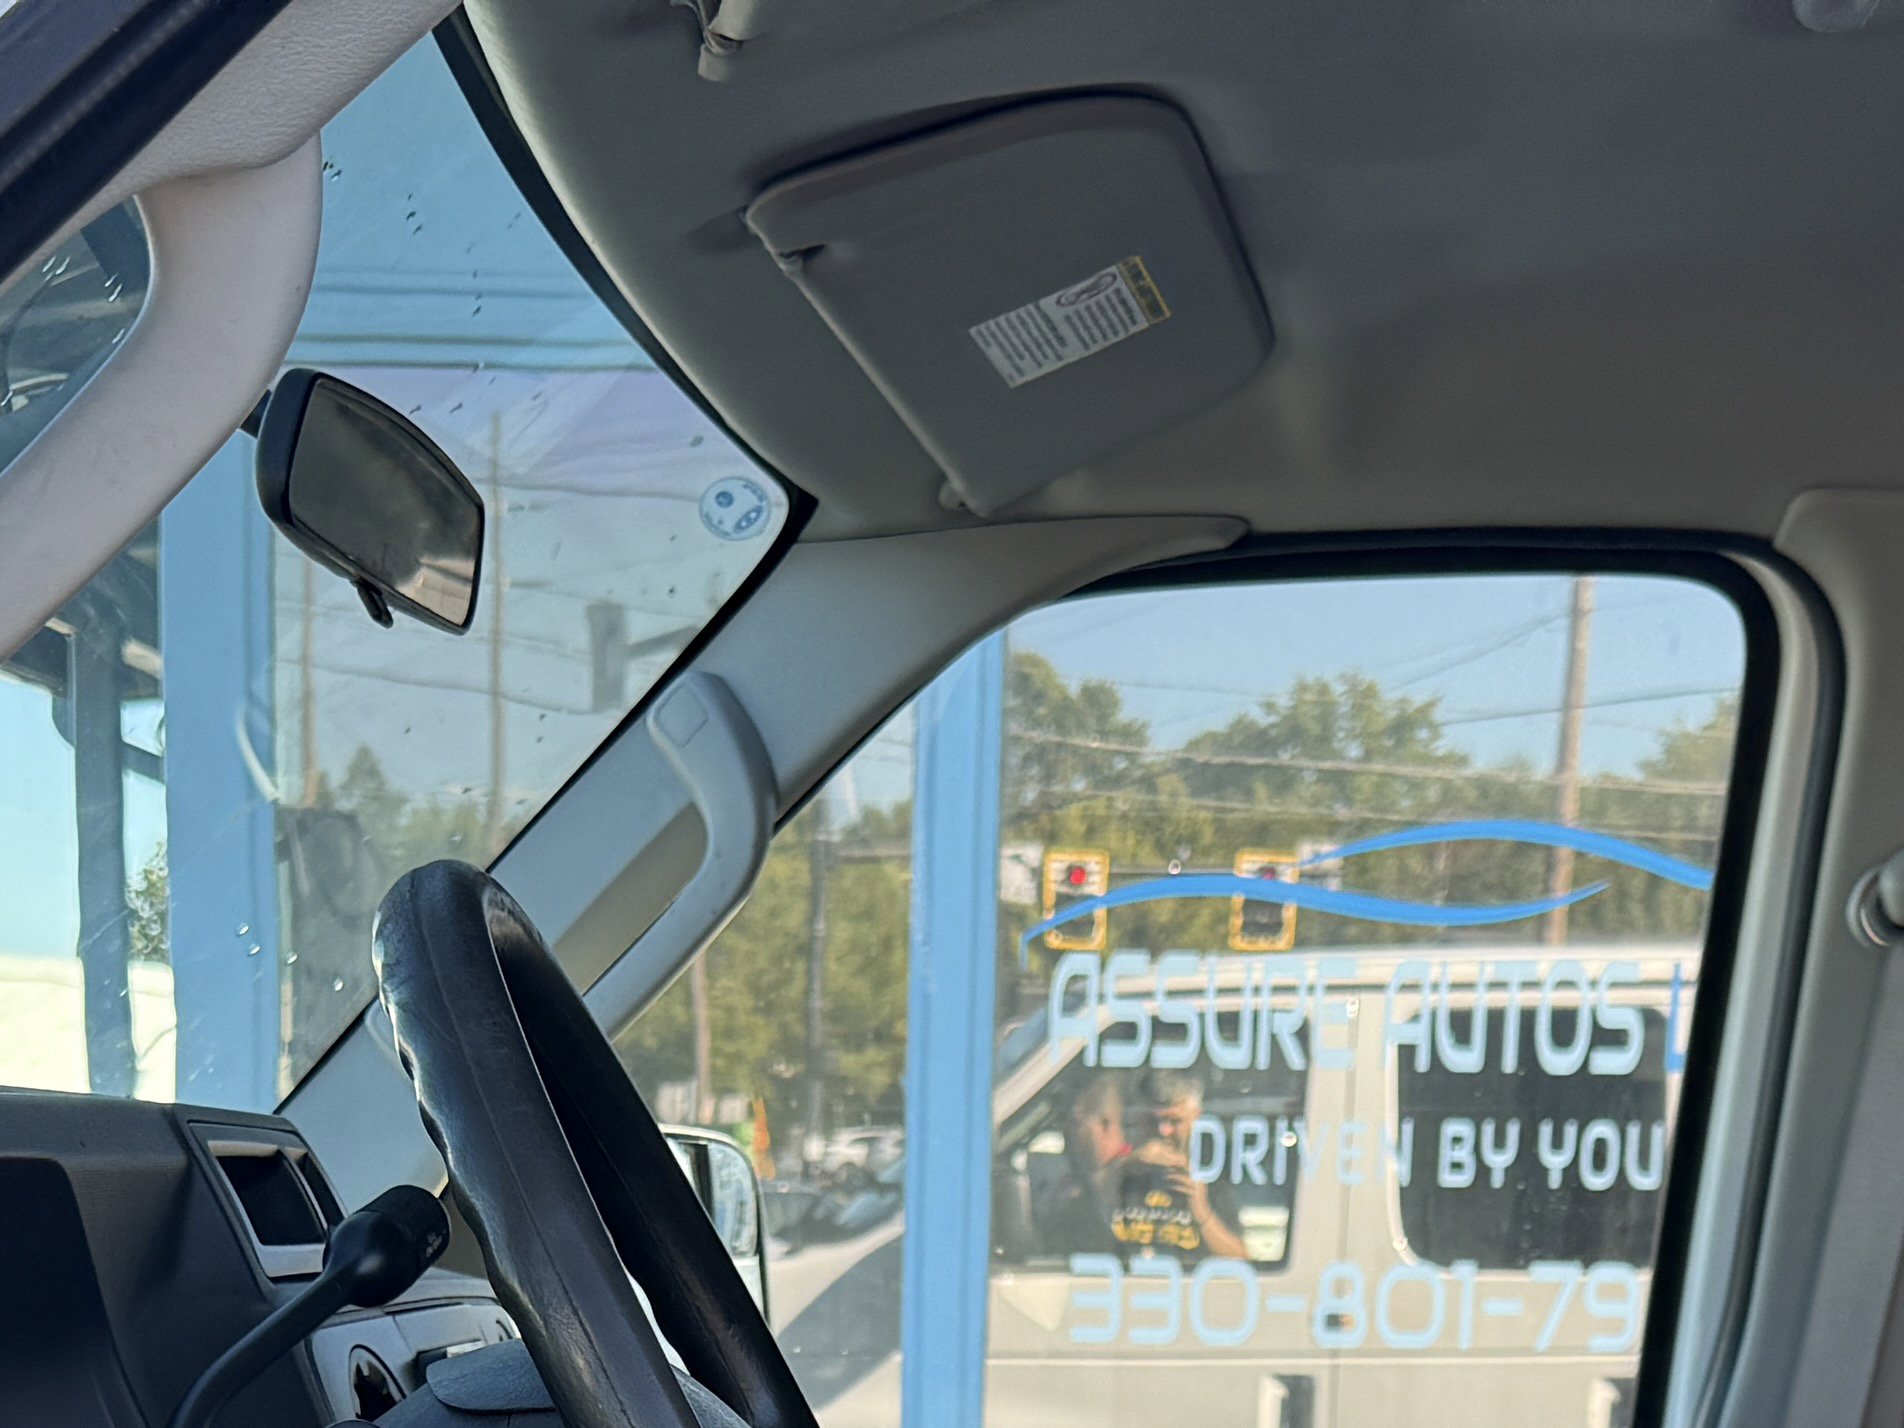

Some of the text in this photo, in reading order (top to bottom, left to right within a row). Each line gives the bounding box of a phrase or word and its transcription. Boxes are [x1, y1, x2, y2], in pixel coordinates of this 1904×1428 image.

[1048, 950, 1358, 1070] ASSURE
[1383, 958, 1646, 1076] AUTOS
[1188, 1115, 1665, 1192] DRIVEN BY YOU
